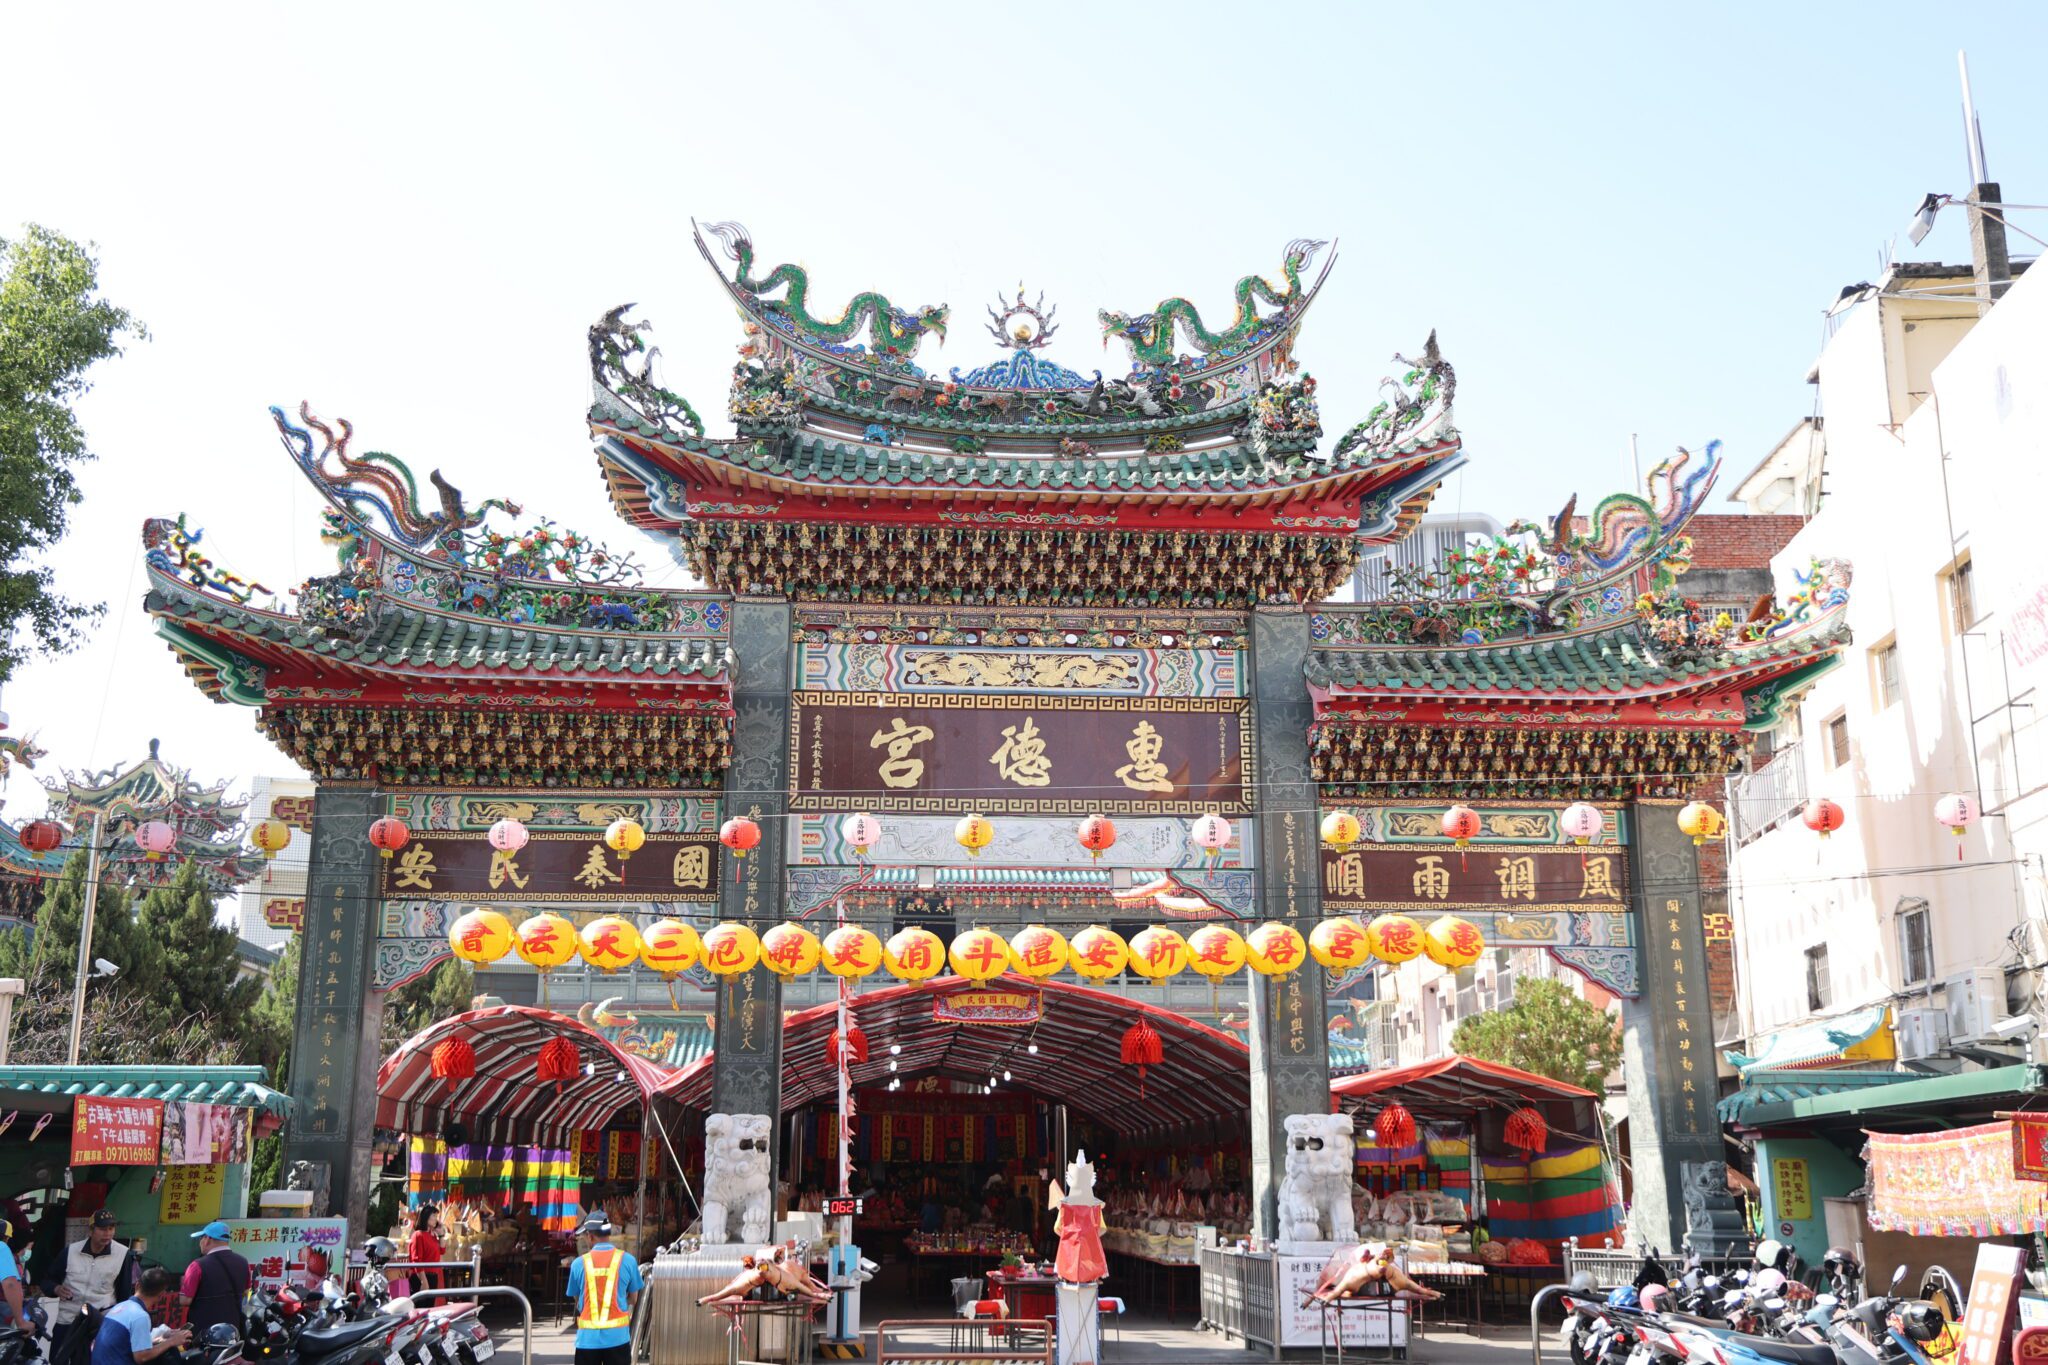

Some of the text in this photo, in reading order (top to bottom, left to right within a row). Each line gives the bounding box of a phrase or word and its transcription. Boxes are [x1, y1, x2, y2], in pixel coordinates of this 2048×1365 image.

[870, 716, 1174, 793] 惠德宮
[831, 1200, 855, 1214] 062
[229, 1226, 279, 1244] 清玉淇
